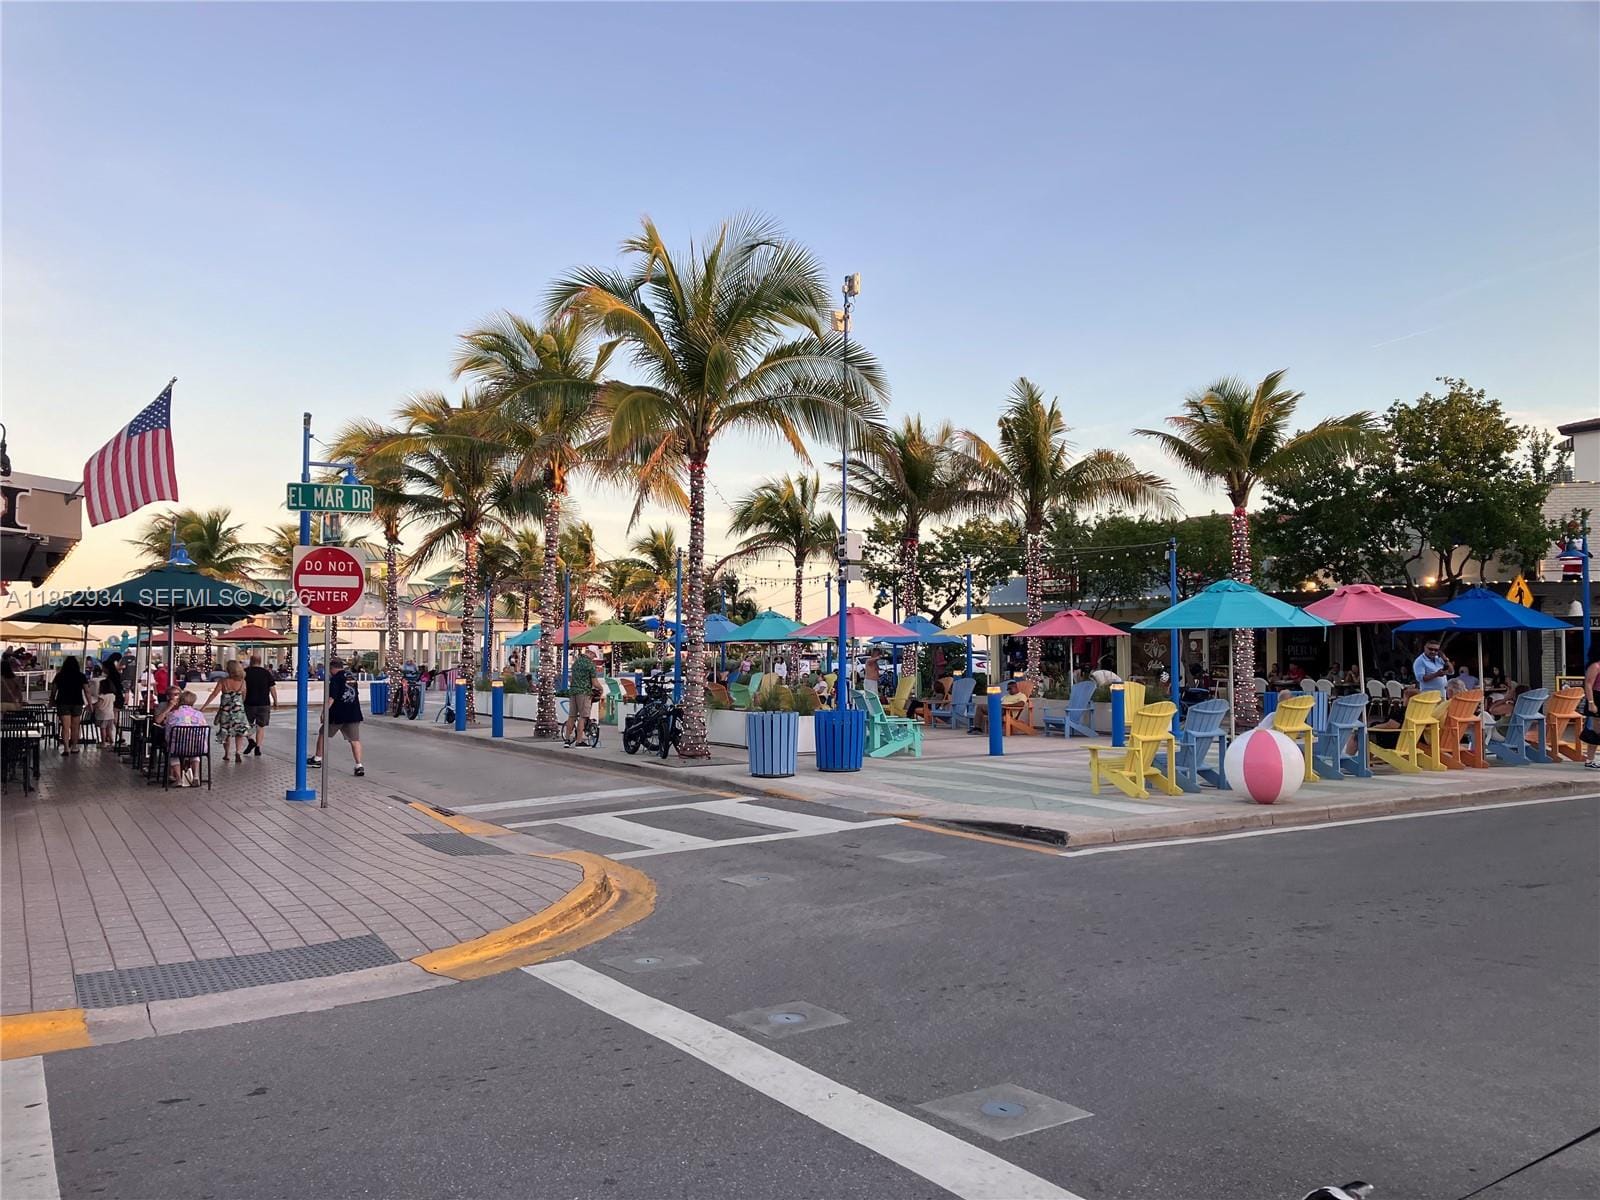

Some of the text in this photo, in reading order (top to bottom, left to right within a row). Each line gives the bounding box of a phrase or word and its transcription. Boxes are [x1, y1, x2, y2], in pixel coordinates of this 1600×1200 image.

[289, 486, 371, 509] EL MAR DR
[305, 560, 354, 572] DO NOT
[310, 590, 348, 602] ENTER
